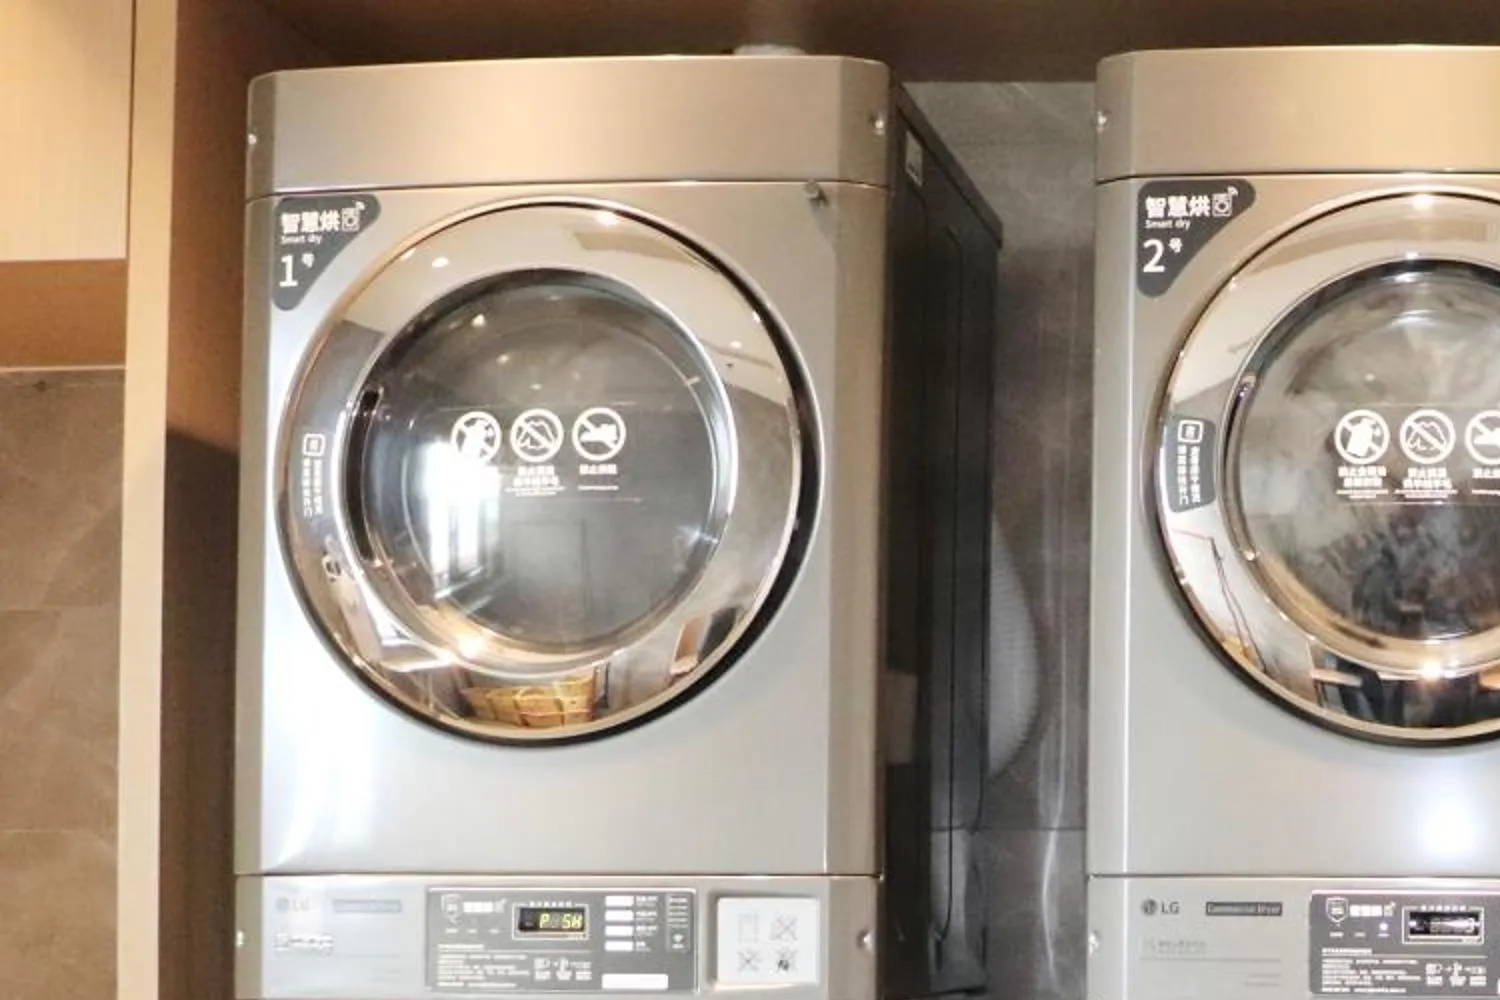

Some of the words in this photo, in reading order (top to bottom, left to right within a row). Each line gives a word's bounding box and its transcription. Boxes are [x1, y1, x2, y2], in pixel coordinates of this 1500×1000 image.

[1146, 195, 1210, 218] 智慧烘
[281, 210, 340, 233] 智慧烘
[1161, 902, 1180, 914] LG
